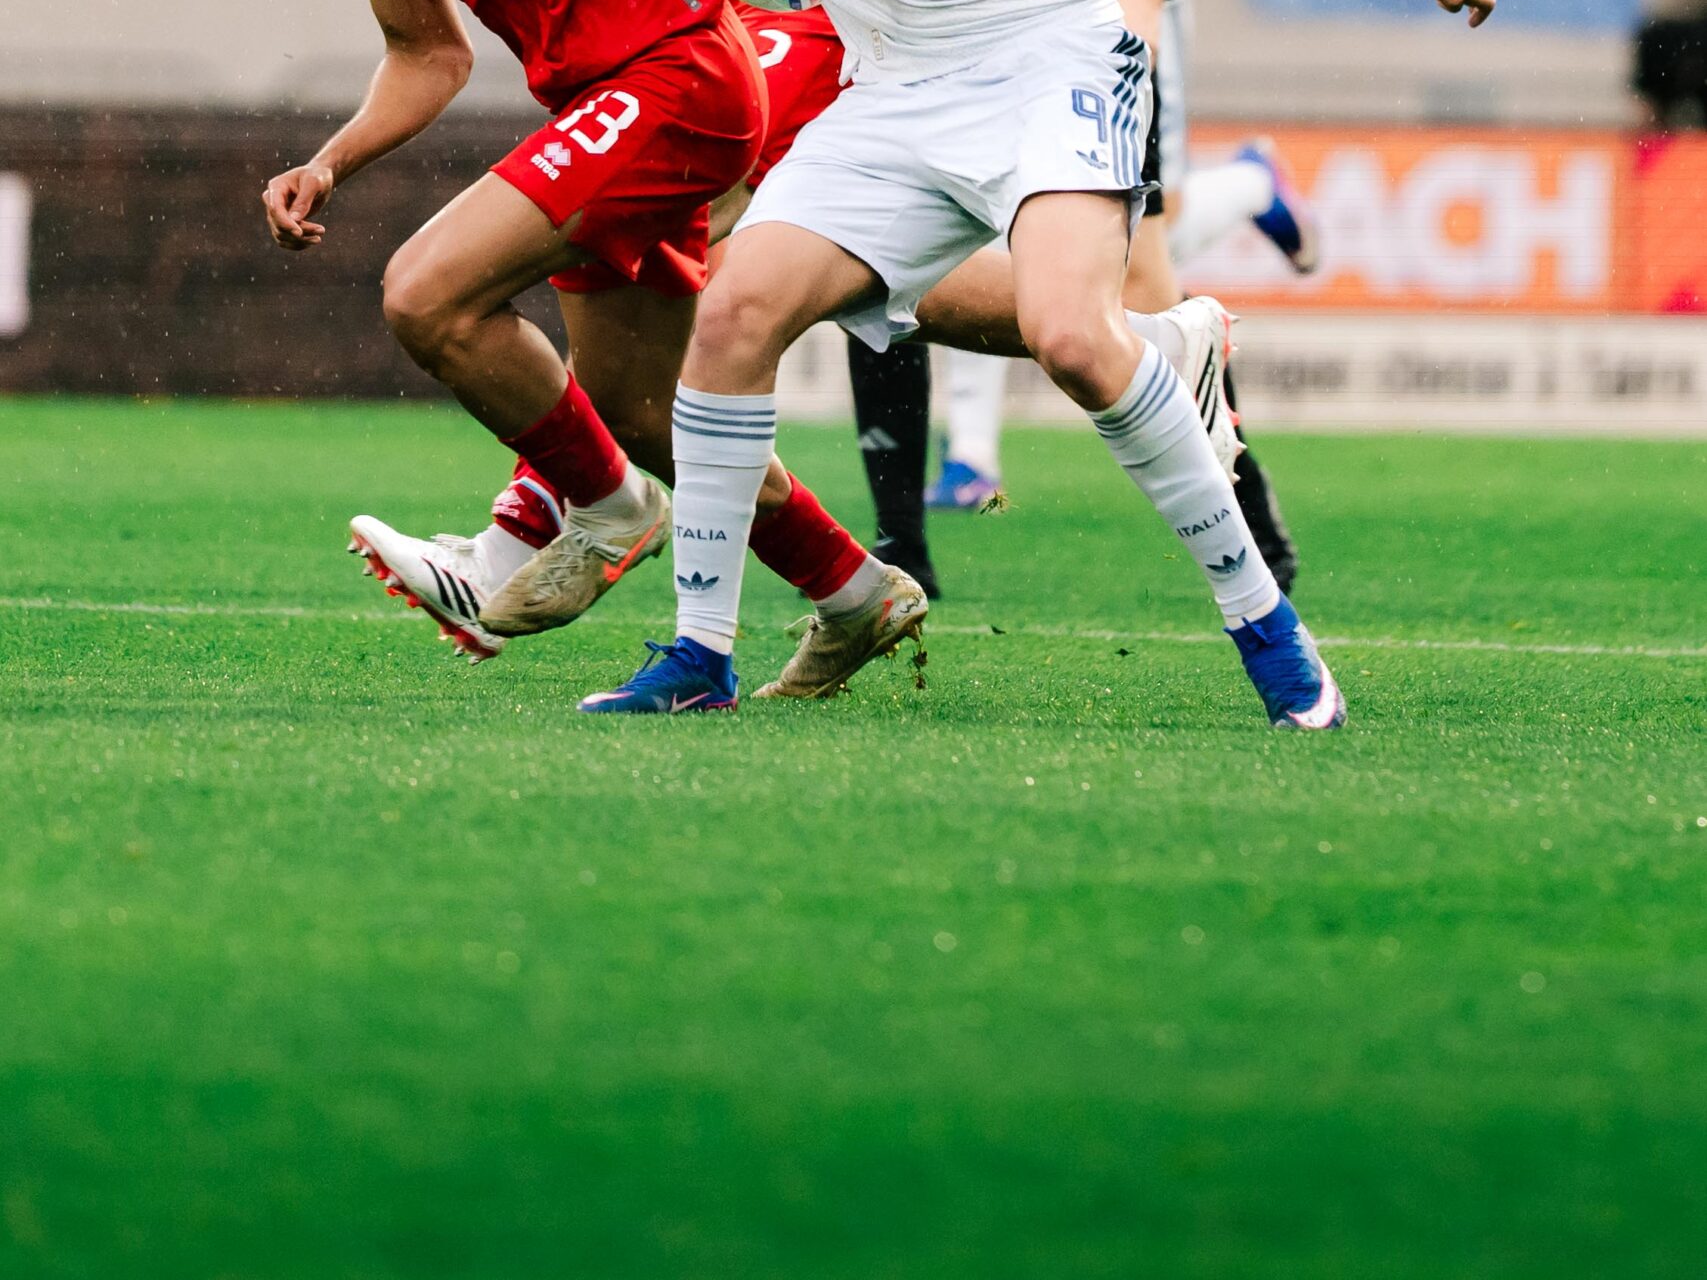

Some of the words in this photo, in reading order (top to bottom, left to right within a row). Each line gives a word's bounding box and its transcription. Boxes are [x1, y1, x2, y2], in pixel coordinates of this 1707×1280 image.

[554, 90, 640, 154] 13
[1072, 89, 1107, 143] 9
[673, 525, 727, 541] TALIA
[1177, 508, 1231, 538] ITALIA
